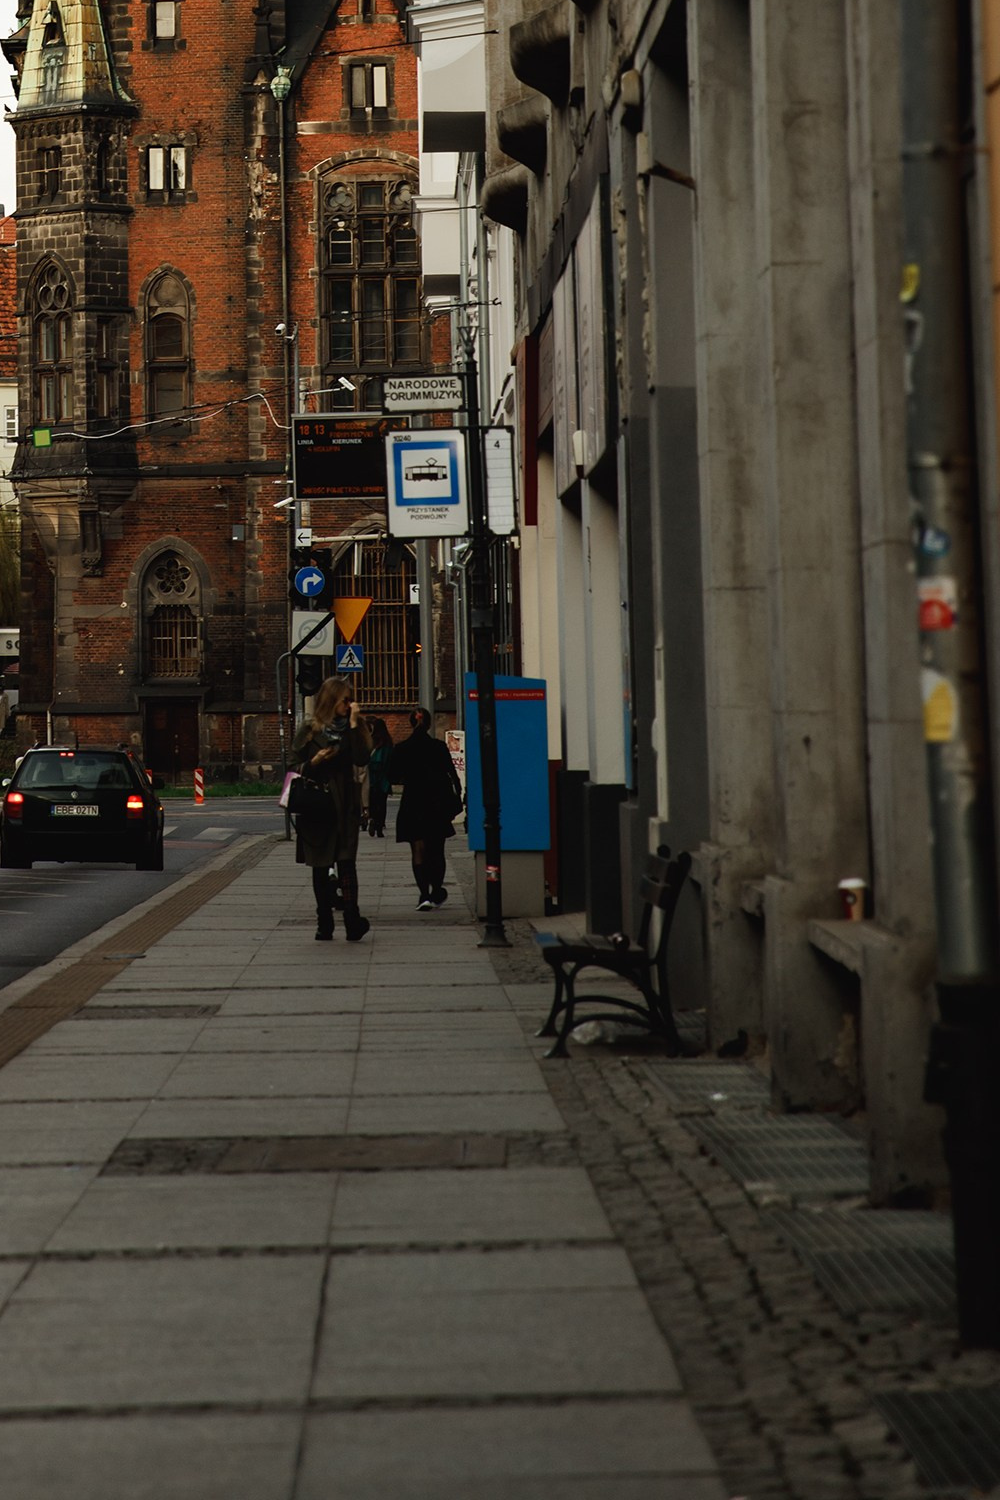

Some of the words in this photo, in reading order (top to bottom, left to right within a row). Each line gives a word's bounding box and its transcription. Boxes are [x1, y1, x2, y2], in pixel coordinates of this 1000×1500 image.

[389, 380, 457, 389] NARODOWE
[385, 392, 422, 401] FORUM
[423, 391, 462, 400] MUZYKI
[299, 425, 310, 435] 18
[315, 424, 325, 435] 13
[494, 440, 500, 448] 4
[55, 805, 75, 815] EBE
